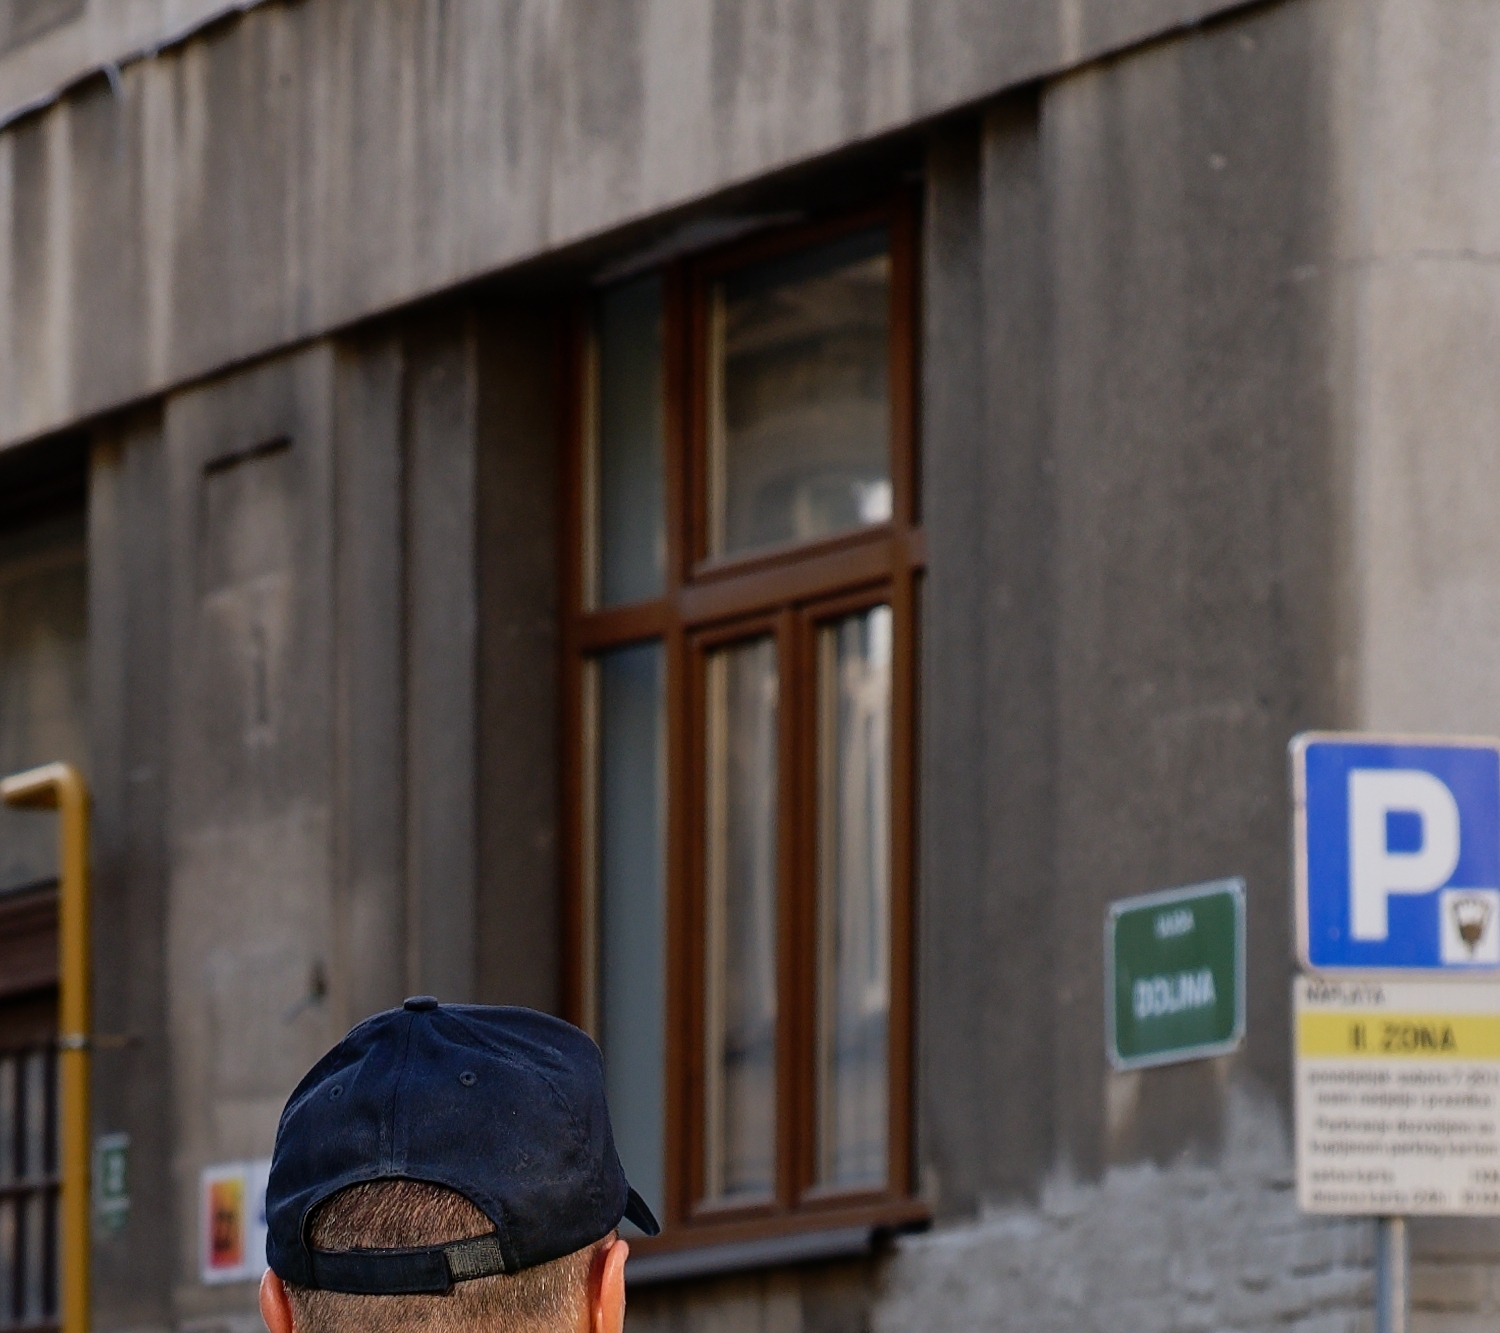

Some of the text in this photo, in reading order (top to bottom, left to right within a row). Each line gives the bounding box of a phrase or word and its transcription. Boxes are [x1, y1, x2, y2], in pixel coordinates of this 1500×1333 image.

[1347, 768, 1461, 941] P
[1133, 966, 1216, 1020] DOLINA
[1381, 1021, 1458, 1051] ZONA
